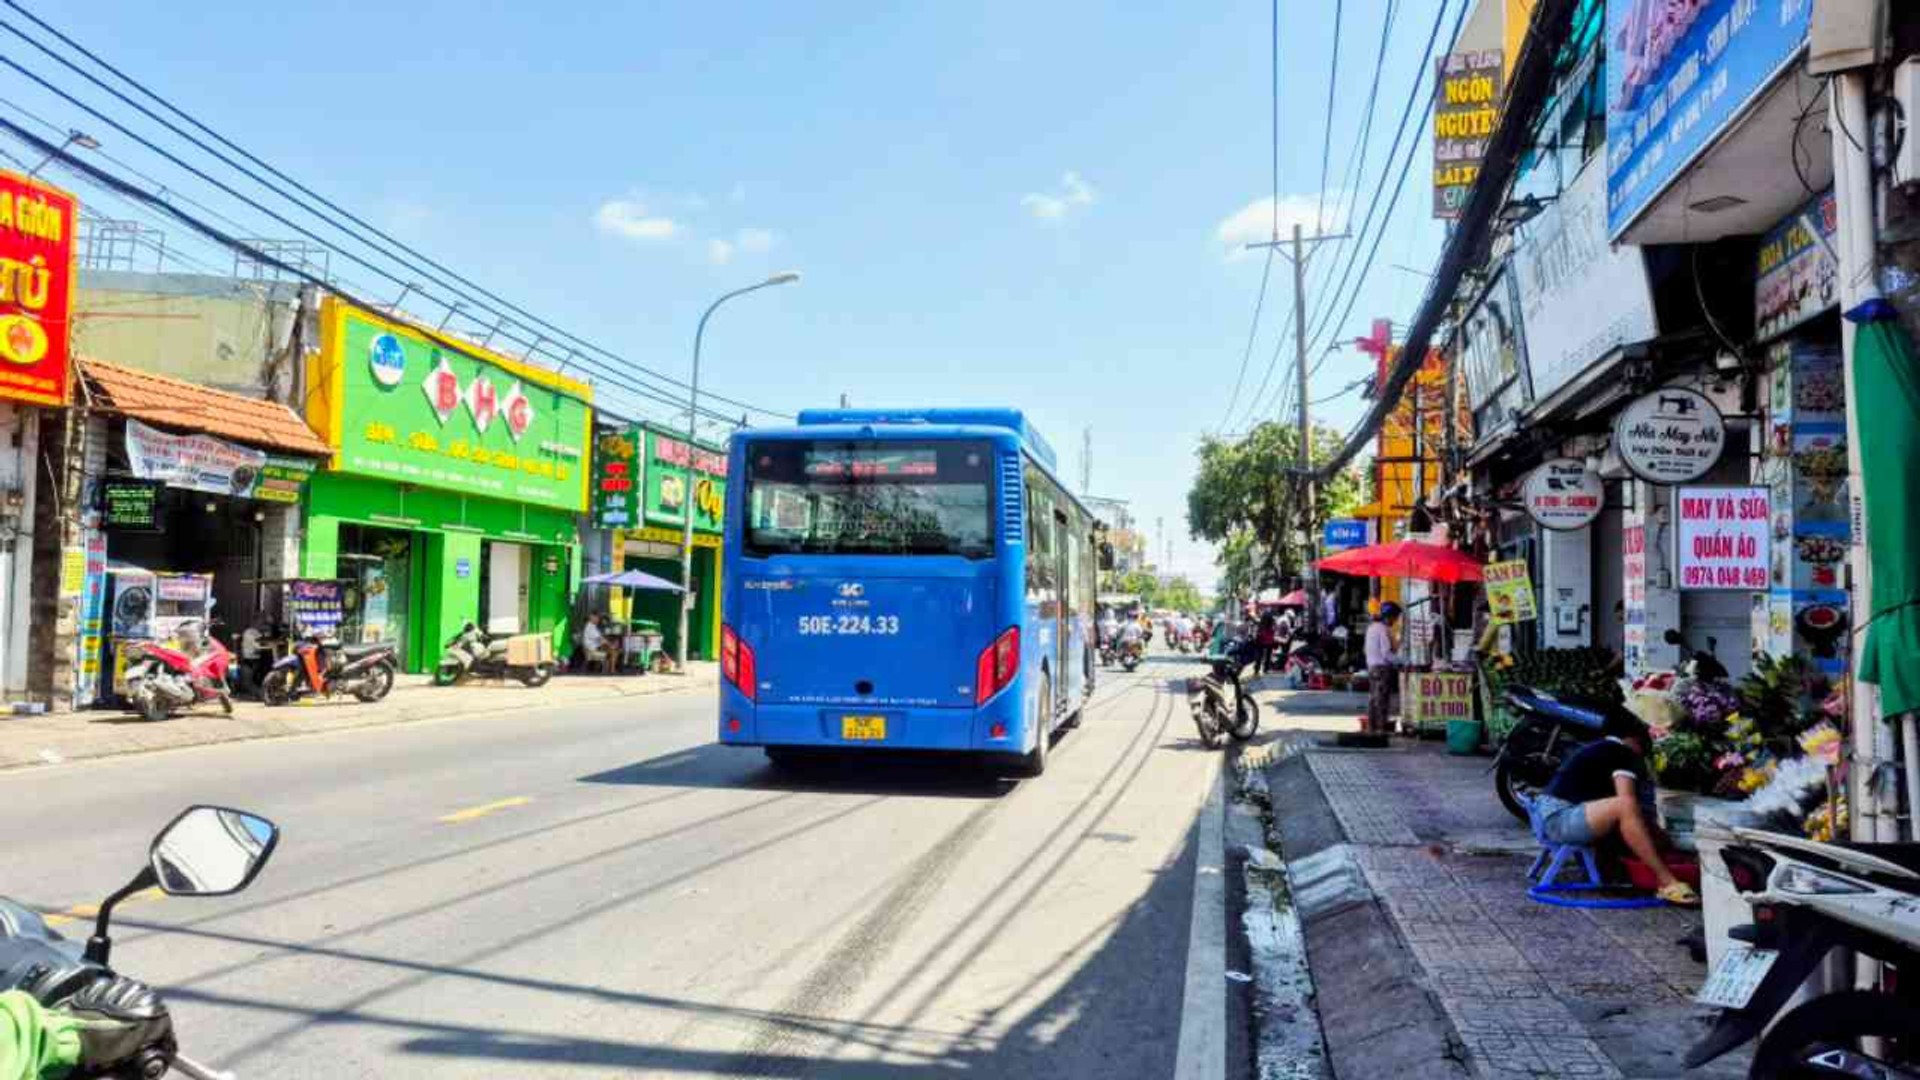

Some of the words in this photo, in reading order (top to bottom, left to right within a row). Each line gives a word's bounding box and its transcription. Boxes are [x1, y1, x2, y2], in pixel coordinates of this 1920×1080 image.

[1682, 498, 1712, 520] MAY
[1716, 492, 1735, 520] VÀ
[798, 615, 899, 635] 50E-224.33
